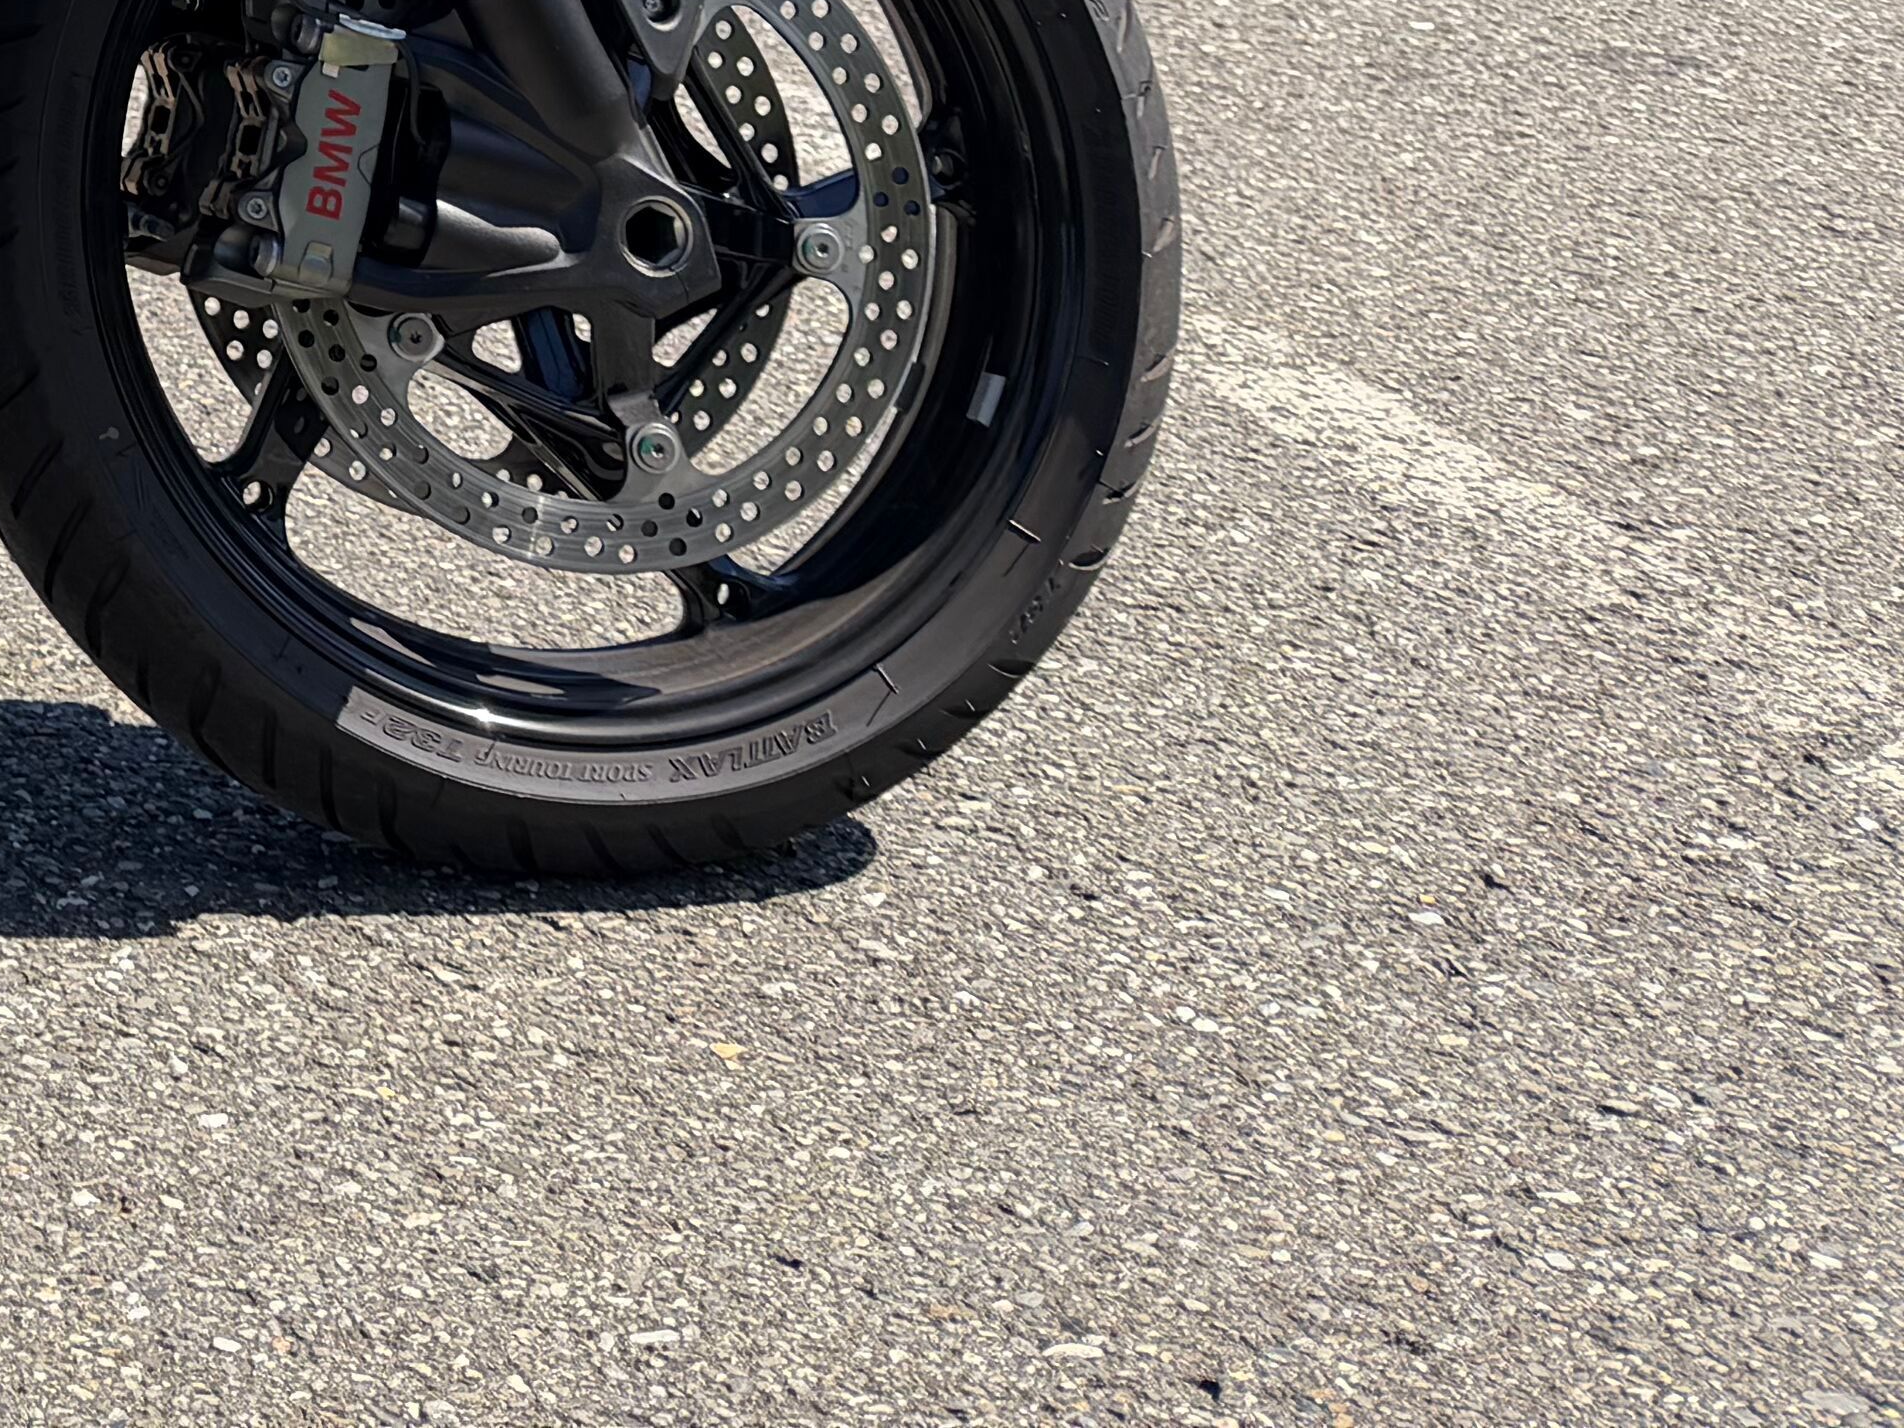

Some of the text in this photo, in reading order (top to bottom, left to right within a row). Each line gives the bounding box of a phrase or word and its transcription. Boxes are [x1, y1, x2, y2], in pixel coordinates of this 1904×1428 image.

[305, 88, 364, 222] BMW
[473, 742, 576, 782] TOURING
[578, 762, 653, 784] SPORT
[668, 709, 839, 783] BATTLAX
